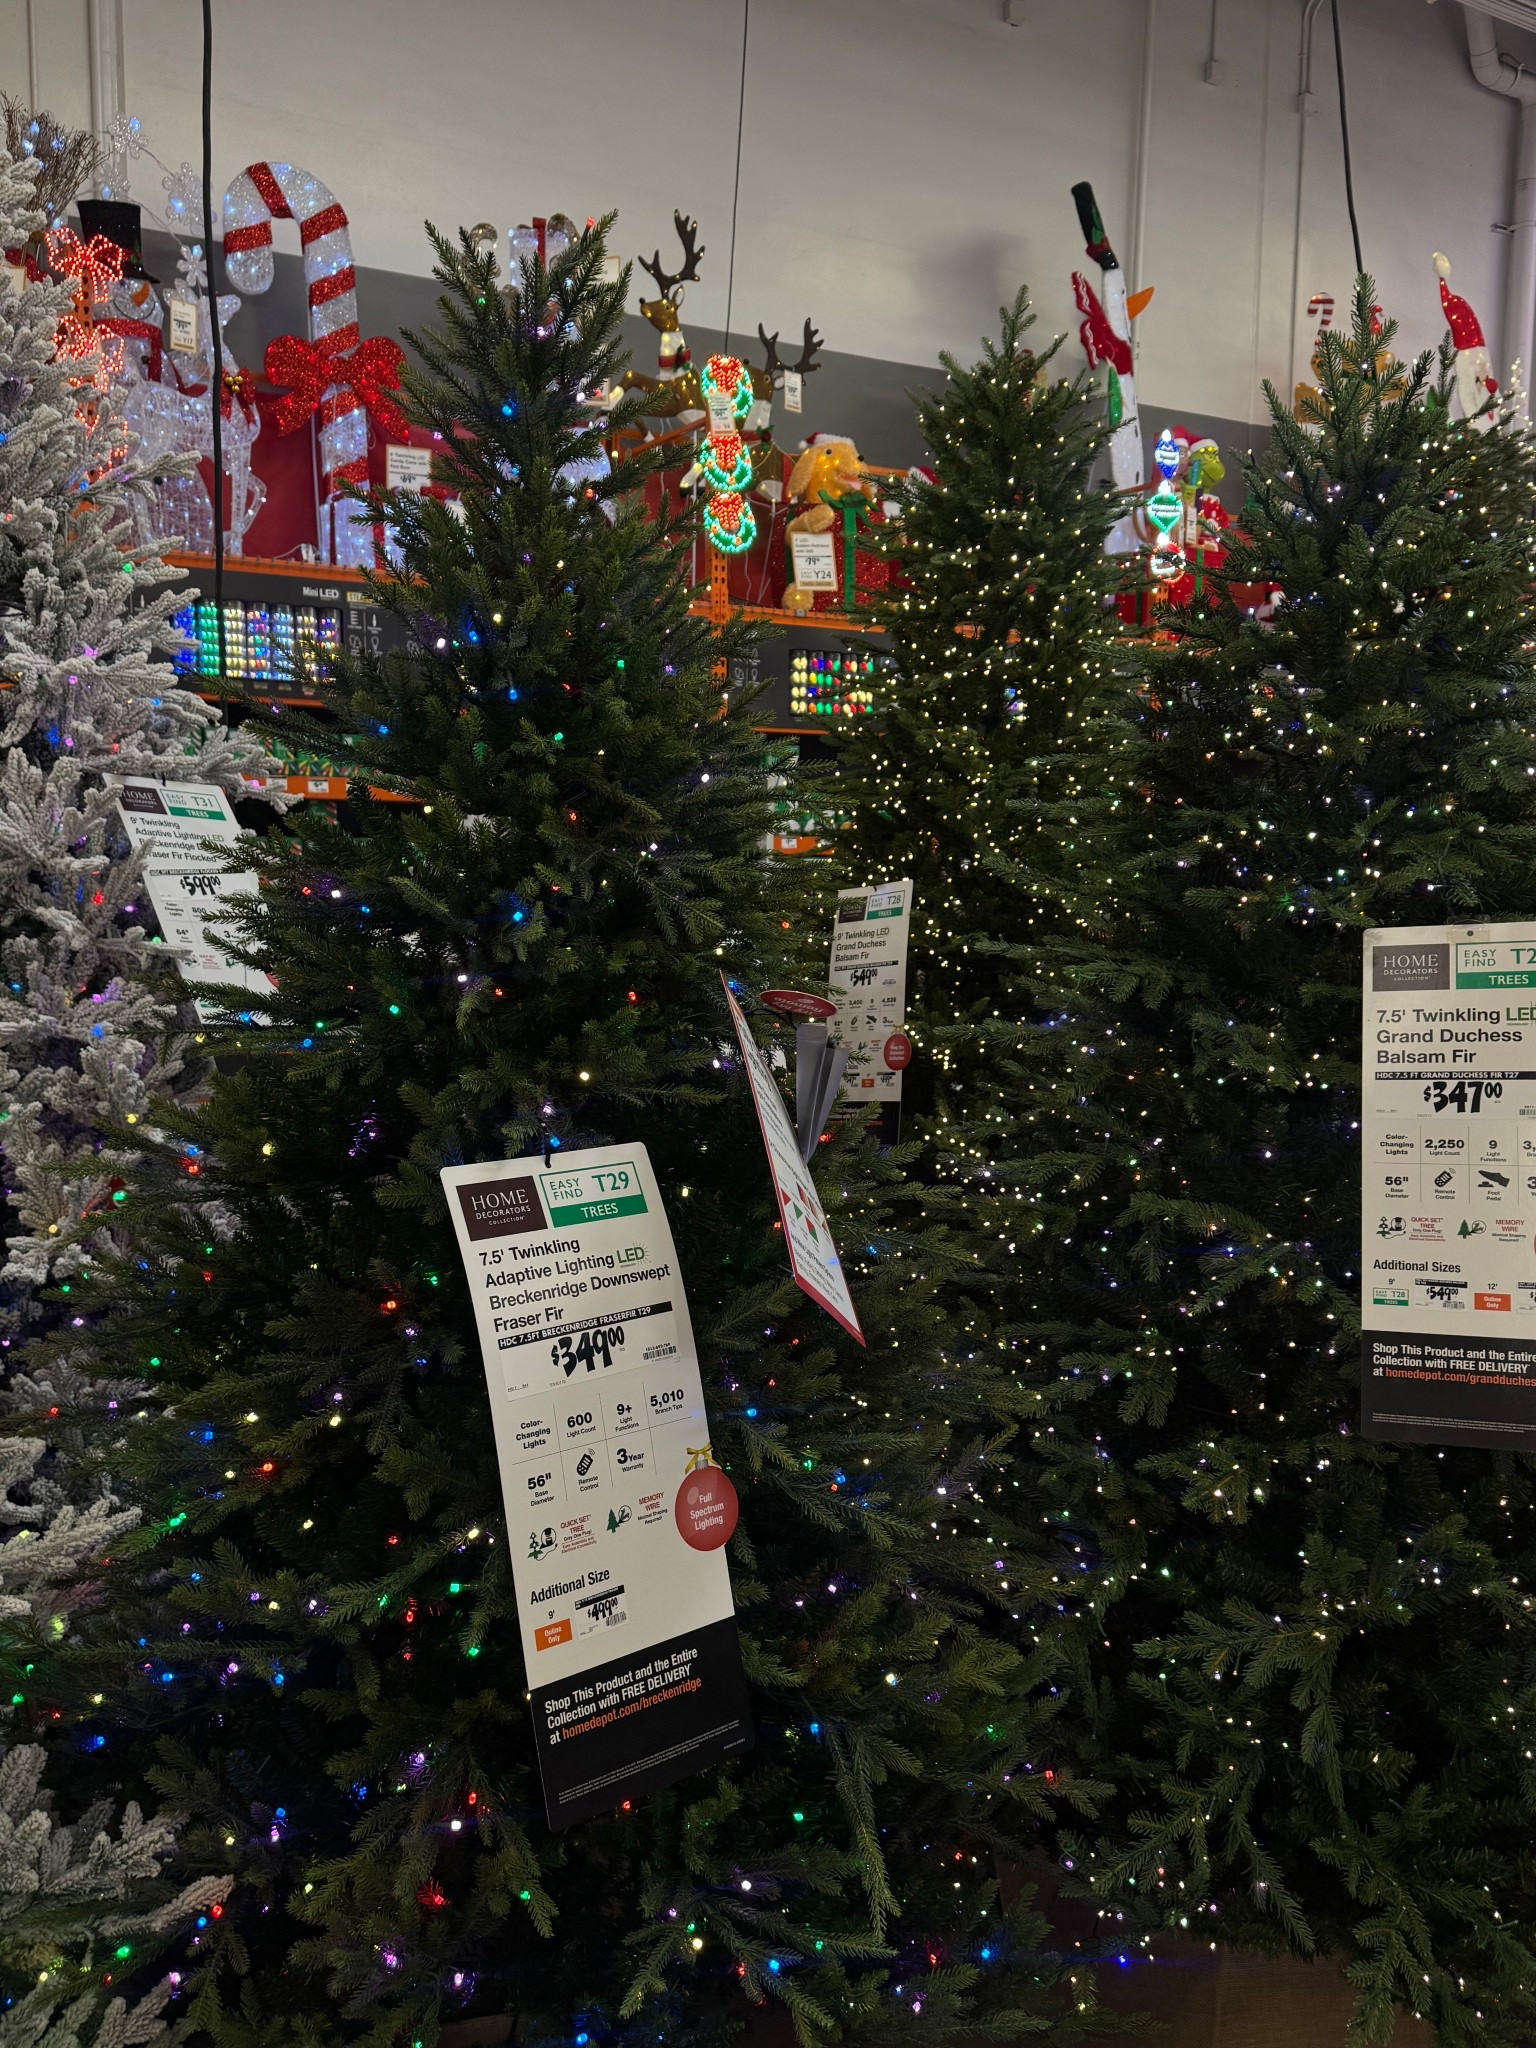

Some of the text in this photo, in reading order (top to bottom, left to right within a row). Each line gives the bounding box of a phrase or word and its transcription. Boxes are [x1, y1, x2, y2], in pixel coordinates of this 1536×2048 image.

[814, 570, 832, 579] Y24
[302, 586, 319, 597] Mini
[319, 588, 340, 599] LED
[122, 790, 156, 801] HOME
[165, 792, 214, 808] EASY T31
[186, 809, 209, 818] TREES
[129, 816, 180, 829] 9' Twinkling
[135, 828, 225, 843] Adaptive Lighting LED
[139, 838, 196, 851] Bckenridge
[147, 850, 217, 863] raser Fir Flocked
[887, 895, 902, 906] T28
[192, 906, 207, 914] 800
[837, 927, 890, 941] 9' Twinkling LED
[836, 939, 887, 952] Grand Duchess
[835, 951, 870, 962] Balsam Fir
[1464, 948, 1497, 959] EASY
[1383, 954, 1439, 968] HOME
[1464, 958, 1496, 967] FIND
[1383, 967, 1438, 976] DECORATORS
[1488, 974, 1529, 985] TREES
[1376, 1007, 1501, 1025] 7.5' Twinkling
[1376, 1028, 1523, 1043] Grand Duchess
[1376, 1049, 1477, 1064] Balsam Fir
[1379, 1141, 1415, 1149] Changing
[1424, 1138, 1465, 1150] 2,250
[1488, 1139, 1498, 1150] 9
[549, 1170, 629, 1193] EASY T29
[1384, 1176, 1409, 1186] 56"
[471, 1188, 529, 1211] HOME
[553, 1188, 583, 1201] FIND
[475, 1205, 531, 1220] DECORATORS
[580, 1202, 619, 1219] TREES
[488, 1216, 525, 1226] COLLECTION
[478, 1239, 581, 1267] 7.5' Twinkling
[485, 1246, 645, 1288] Adaptive Lighting LED
[1373, 1258, 1462, 1273] Additional Sizes
[489, 1263, 671, 1311] Breckenridge Downswept
[1487, 1282, 1498, 1290] 12'
[493, 1306, 564, 1333] Fraser Fir
[499, 1306, 652, 1348] HDC 7.5FT BRECKENRIDGE FRASERFIR T29
[1372, 1342, 1536, 1363] Shop This Product and the Entire
[1372, 1354, 1529, 1374] Collection with FREE DELIVERY
[1372, 1366, 1384, 1377] at
[650, 1388, 684, 1408] 5,010
[616, 1403, 633, 1416] 9+
[654, 1403, 683, 1415] Branch Tips
[520, 1419, 543, 1430] Color-
[566, 1411, 593, 1428] 600
[619, 1416, 633, 1425] Light
[566, 1425, 597, 1438] Light Count
[615, 1421, 640, 1433] Functions
[515, 1427, 551, 1441] Changing
[523, 1438, 547, 1450] Lights
[616, 1447, 645, 1465] 3 Year
[621, 1462, 644, 1473] Warranty
[527, 1472, 552, 1490] 56"
[578, 1475, 599, 1486] Remote
[579, 1482, 599, 1492] Control
[534, 1489, 549, 1498] Base
[638, 1491, 665, 1505] MEMORY
[698, 1492, 713, 1504] Full
[530, 1495, 555, 1507] Diameter
[644, 1501, 661, 1511] WIRE
[689, 1502, 725, 1520] Spectrum
[560, 1517, 579, 1529] QUICK
[569, 1524, 585, 1534] TREE
[694, 1514, 724, 1531] Lighting
[530, 1574, 586, 1606] Additional
[587, 1569, 610, 1586] Size
[548, 1609, 555, 1620] 9'
[544, 1626, 562, 1637] Online
[547, 1633, 561, 1644] Only
[544, 1647, 698, 1714] Shop This Product and the Entire
[547, 1664, 691, 1730] Collection with FREE DELIVERY
[549, 1676, 702, 1745] at homedepot.com/breckenridge
